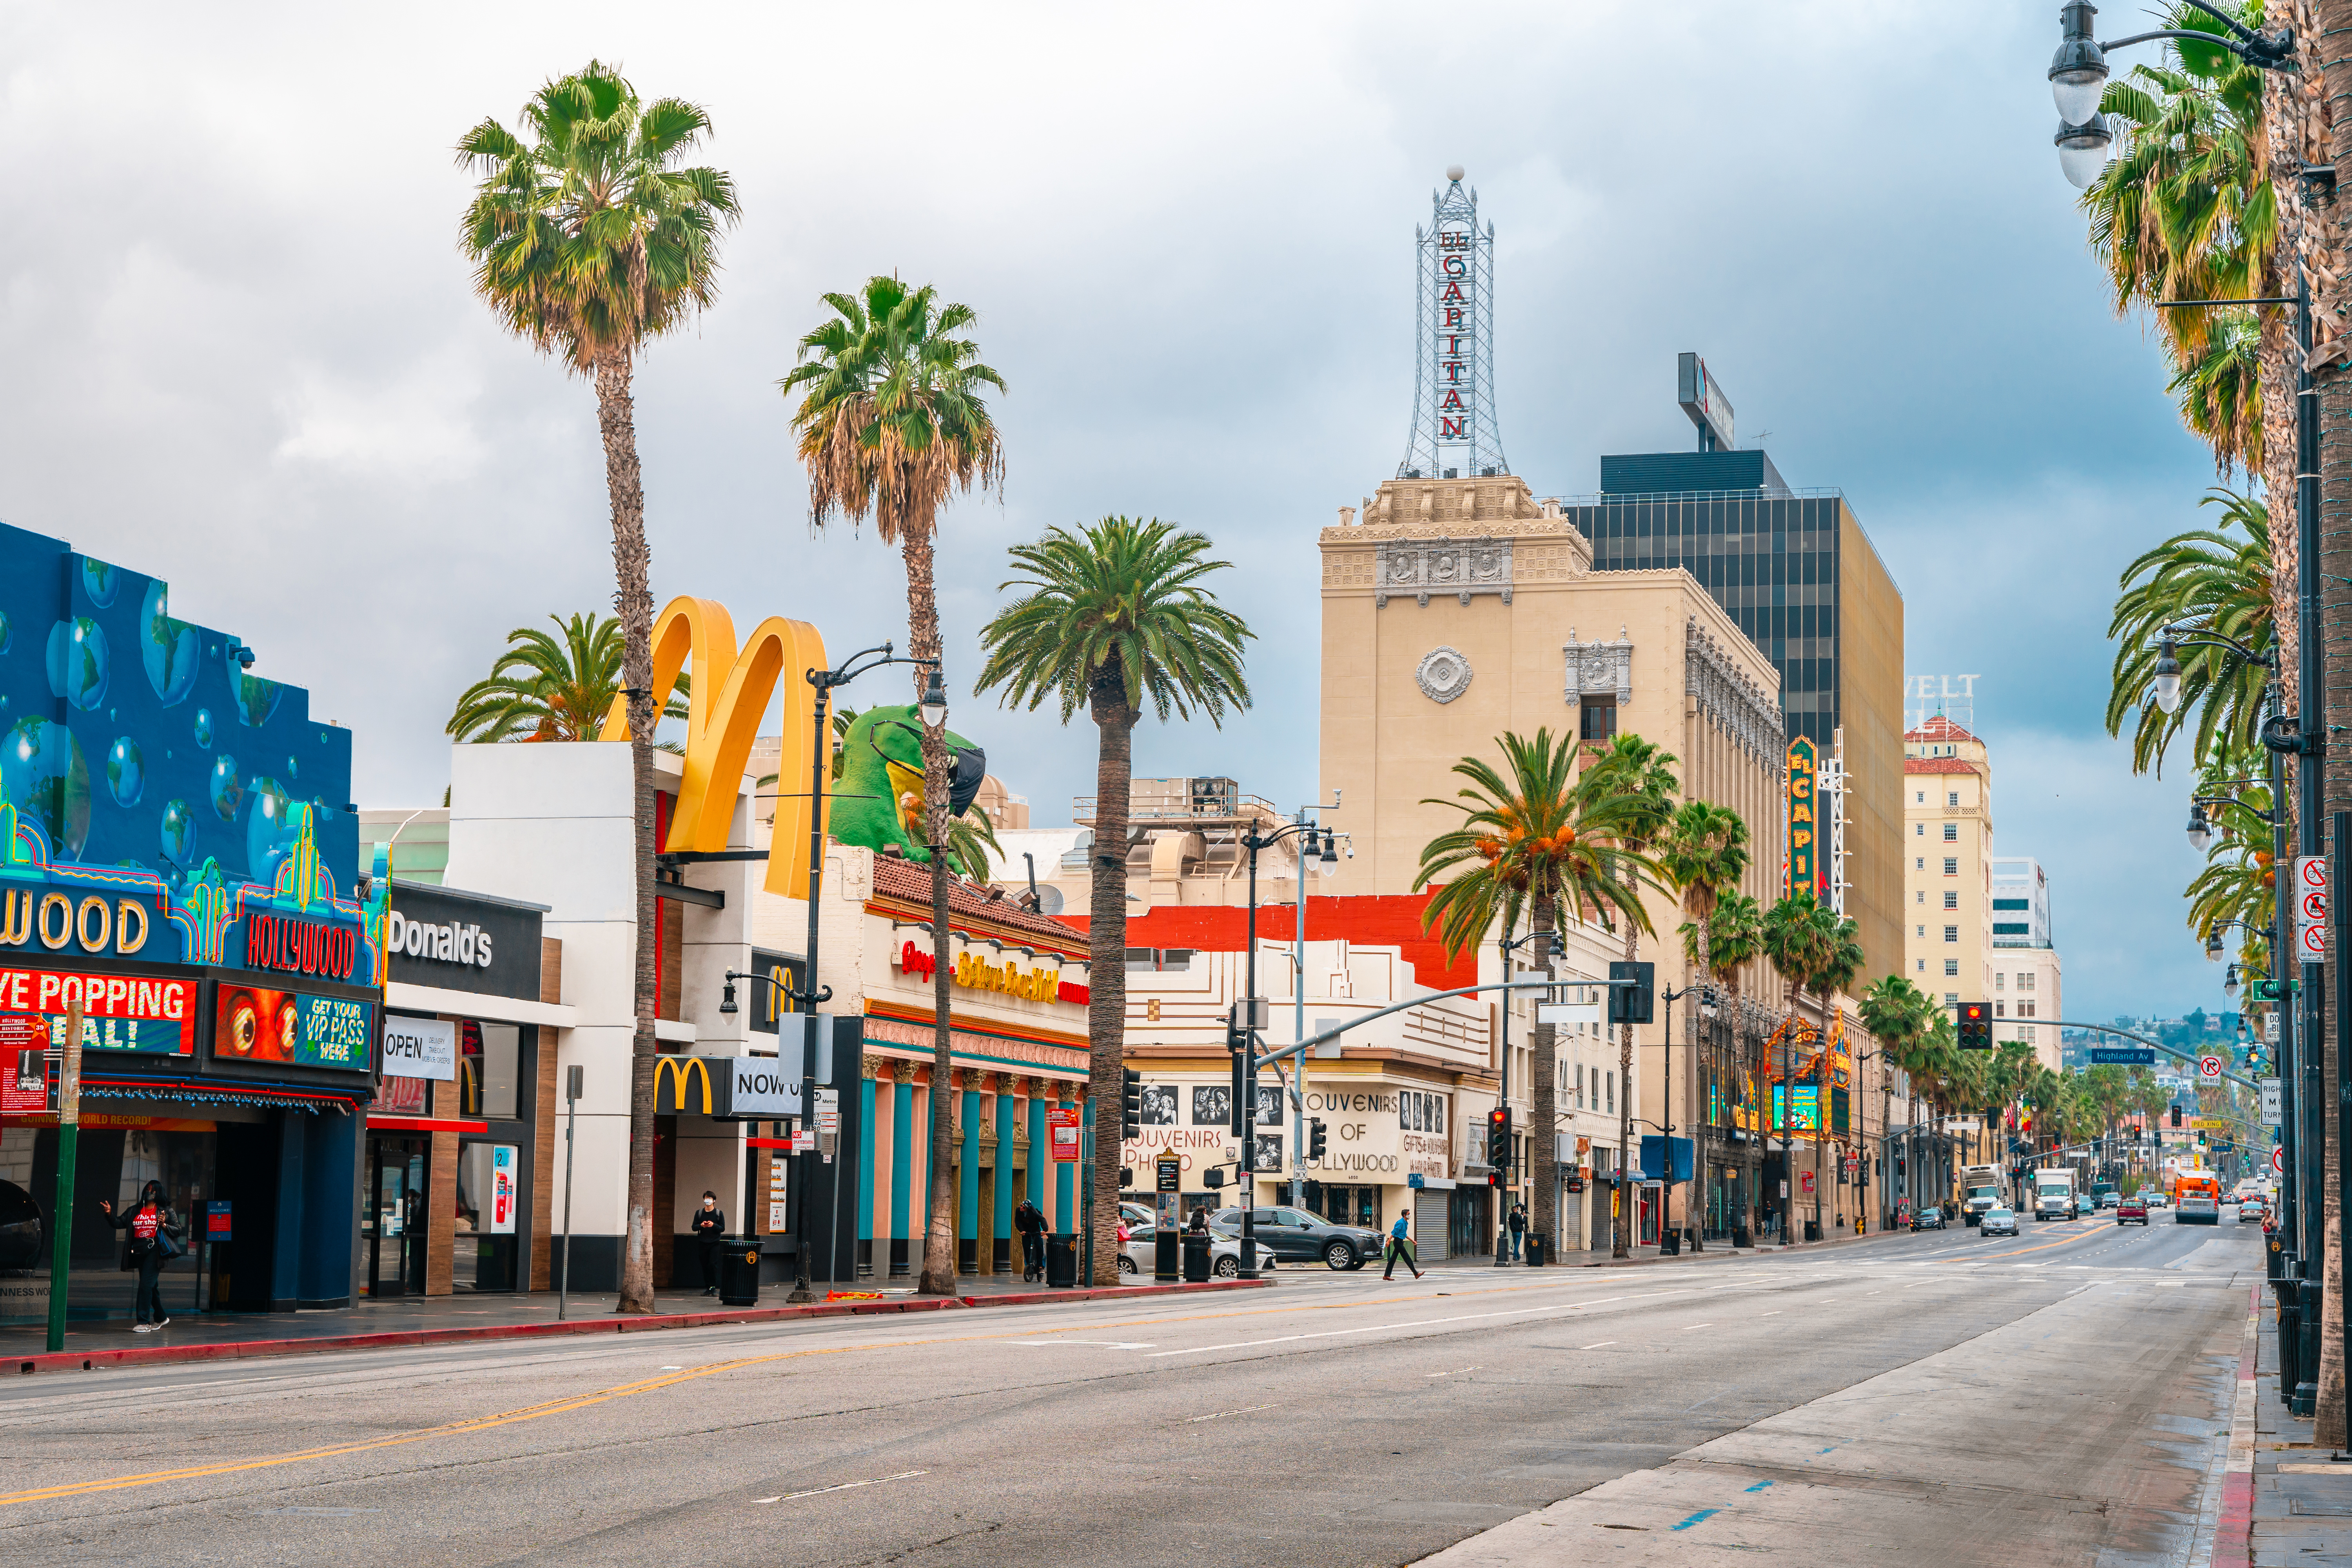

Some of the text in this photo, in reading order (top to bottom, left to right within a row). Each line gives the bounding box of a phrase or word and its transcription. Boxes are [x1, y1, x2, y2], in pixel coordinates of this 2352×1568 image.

[1440, 232, 1466, 436] EL CAPITAN
[1791, 754, 1813, 774] EL
[247, 913, 355, 979] HOLLYWOOD
[388, 910, 492, 967] Donald's
[956, 951, 1004, 992] Believe
[1004, 961, 1018, 996] It
[1017, 974, 1032, 999] or
[1031, 967, 1059, 1005] Not!
[40, 974, 184, 1018] POPPING
[312, 999, 361, 1019] GET YOUR
[2270, 1015, 2279, 1023] DO
[306, 1014, 365, 1045] VIP PASS
[320, 1042, 349, 1062] HERE
[385, 1034, 423, 1059] OPEN
[437, 1056, 450, 1064] ORDERS
[2097, 1052, 2134, 1062] Highland
[739, 1074, 784, 1095] NOW
[1307, 1093, 1398, 1113] OUVENIRS
[21, 1114, 59, 1123] GUINNE
[111, 1116, 151, 1125] RECORD!
[1341, 1123, 1366, 1141] OF
[1125, 1149, 1192, 1172] PHO
